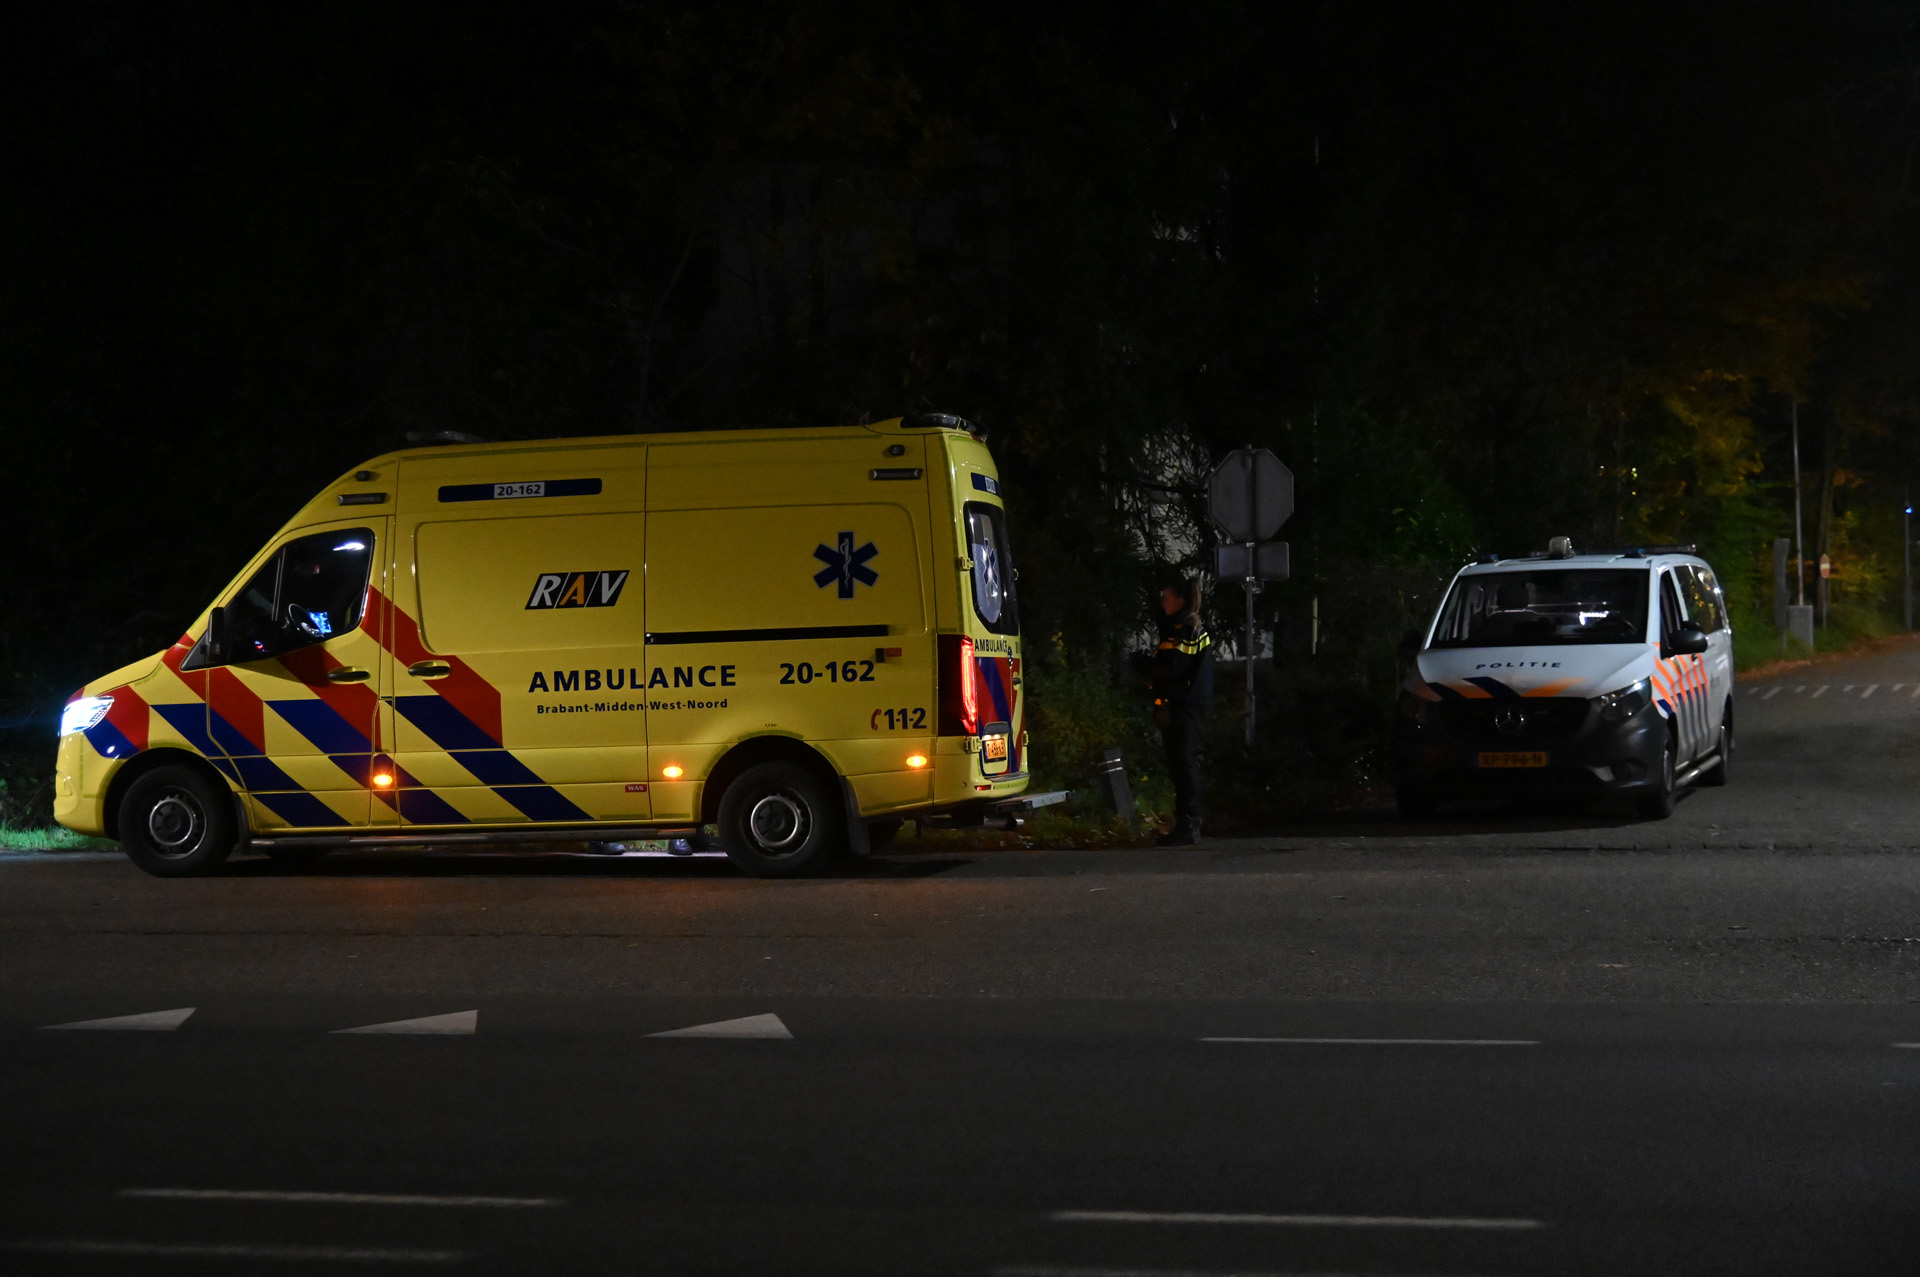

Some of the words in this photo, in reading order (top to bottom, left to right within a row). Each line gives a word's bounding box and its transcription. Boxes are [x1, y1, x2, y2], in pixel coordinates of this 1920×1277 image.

[497, 484, 541, 496] 20-162
[529, 572, 627, 607] RAV
[974, 639, 1008, 652] AMBULANCE
[780, 660, 875, 684] 20-162
[1475, 661, 1561, 670] POLITIE
[528, 665, 736, 692] AMBULANCE
[537, 699, 728, 714] Brabant-Midden-West-Noord
